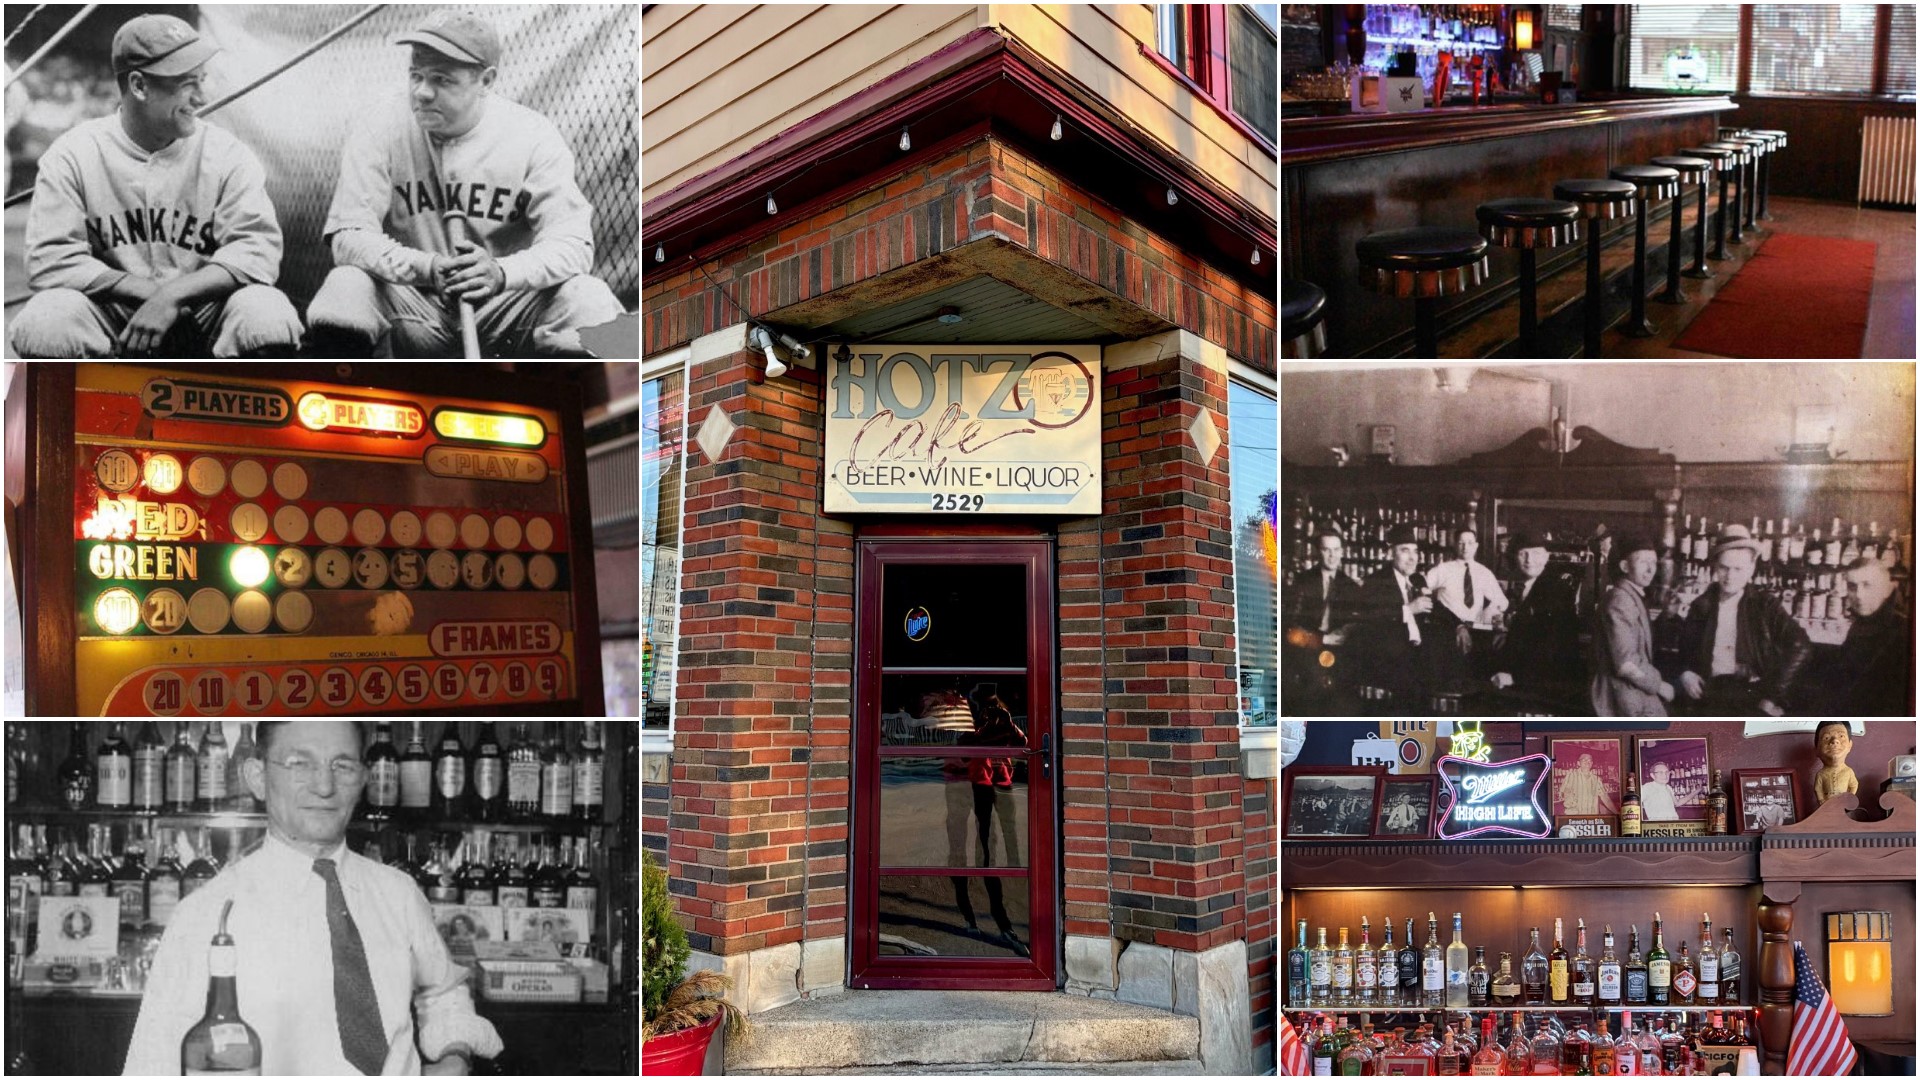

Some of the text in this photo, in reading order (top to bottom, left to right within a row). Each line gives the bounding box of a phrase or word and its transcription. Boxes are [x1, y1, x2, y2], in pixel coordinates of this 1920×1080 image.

[831, 352, 1036, 420] HOTZ
[151, 384, 282, 418] 2 PLAYERS
[441, 414, 539, 441] SECL
[103, 456, 129, 487] 10
[150, 459, 176, 489] 20
[455, 454, 519, 479] PLAY
[846, 466, 1080, 491] BEER WINE LIQUOR
[932, 493, 985, 512] 2529
[89, 545, 198, 581] GREEN
[149, 597, 178, 628] 20
[442, 624, 551, 652] FRAMES
[153, 664, 557, 710] 20 10 1 2 3 4 5 6 7 8 9
[1462, 769, 1526, 804] Miller
[1455, 805, 1534, 821] HIGH LIFE
[1571, 824, 1612, 837] SSLER
[1643, 828, 1685, 837] KESSLER
[1705, 1053, 1740, 1061] IGFO
